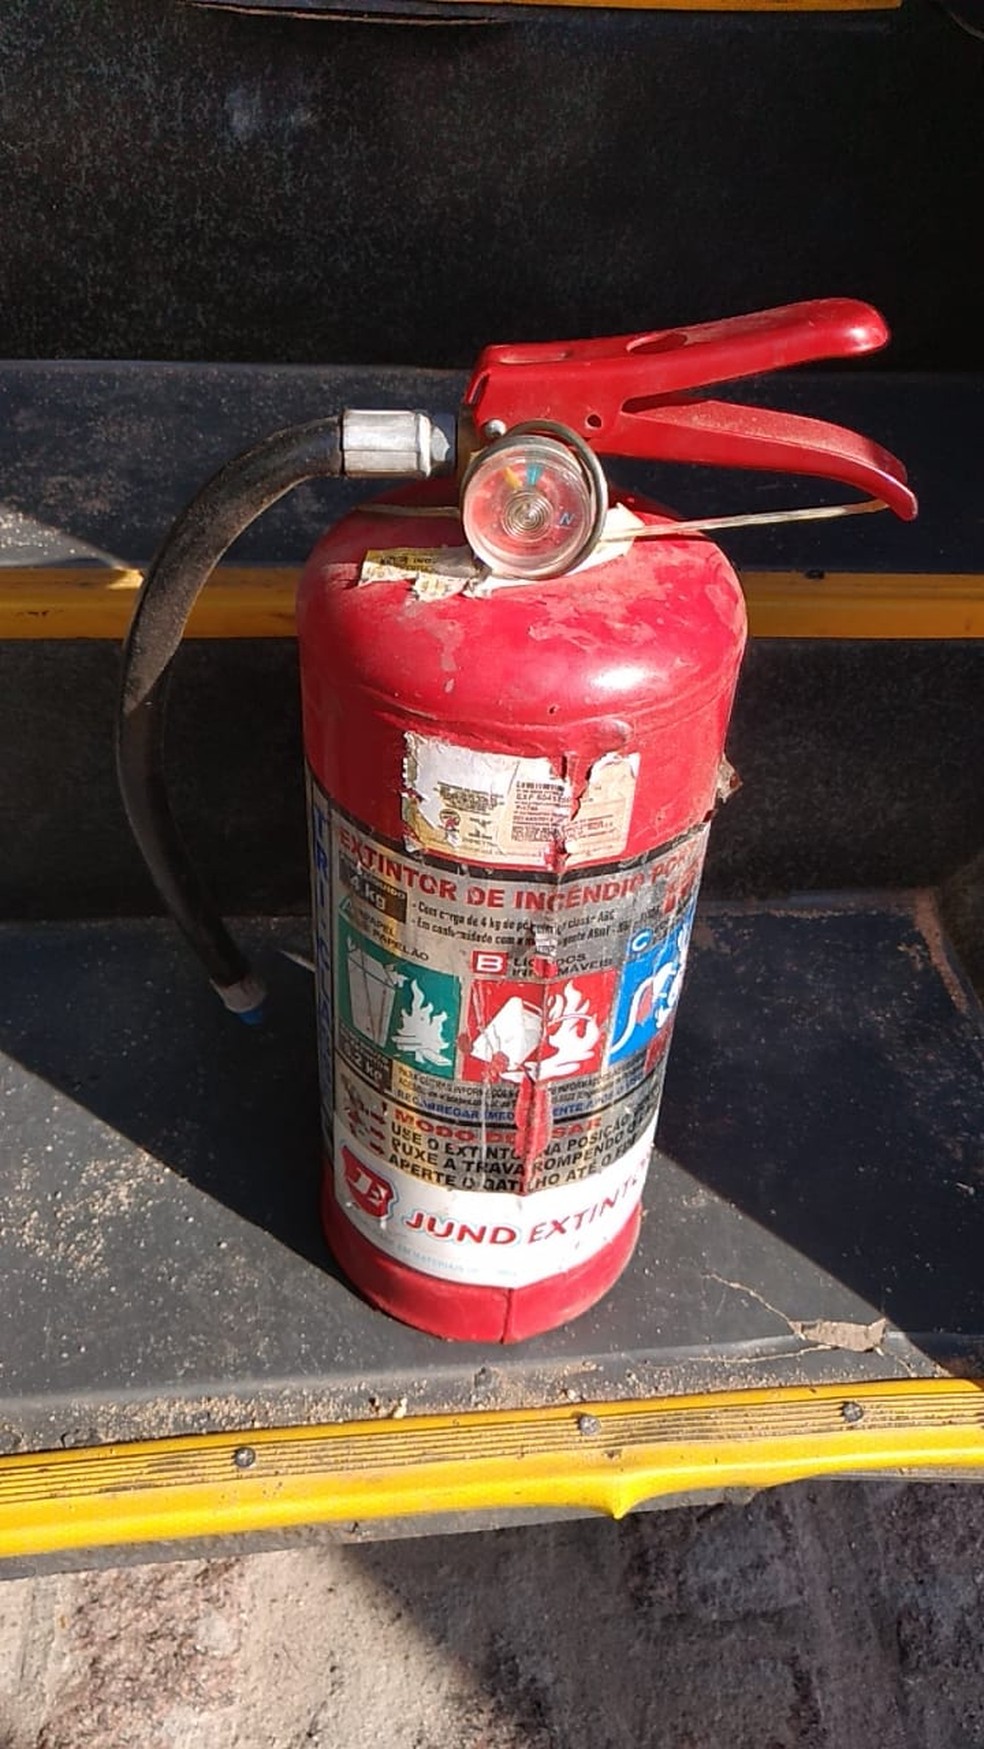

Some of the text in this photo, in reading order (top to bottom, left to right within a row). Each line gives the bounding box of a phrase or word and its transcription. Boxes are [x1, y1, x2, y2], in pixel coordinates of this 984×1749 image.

[339, 827, 457, 902] EXTINTOR
[467, 886, 505, 908] DE
[467, 914, 478, 927] de
[481, 917, 487, 927] 4
[632, 932, 649, 951] C
[477, 954, 504, 972] B
[391, 1121, 422, 1145] USE
[428, 1137, 439, 1150] O
[394, 1107, 475, 1141] MODO
[391, 1137, 438, 1166] PUXE
[444, 1158, 456, 1171] A
[462, 1160, 525, 1176] TRAVA
[532, 1130, 624, 1174] ROMPENDO
[389, 1154, 457, 1188] APERTE
[601, 1154, 612, 1167] O
[405, 1212, 518, 1245] JUND
